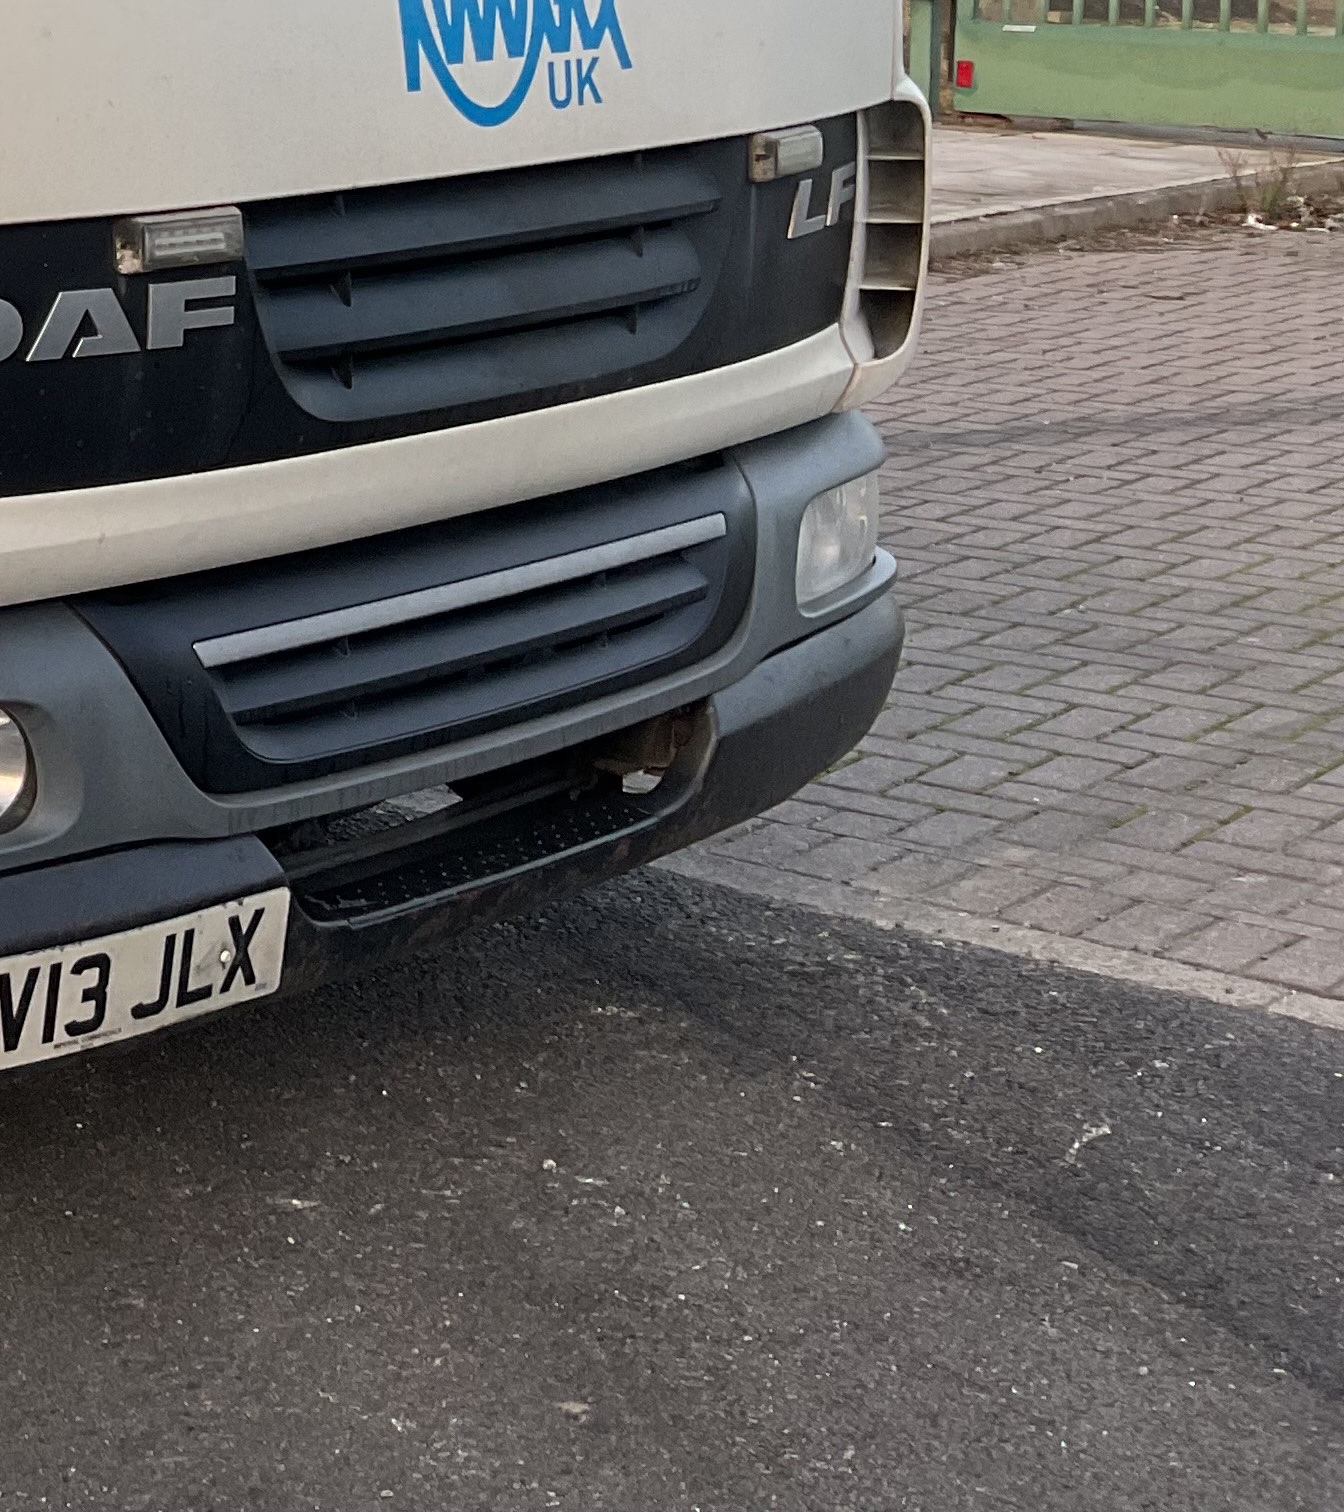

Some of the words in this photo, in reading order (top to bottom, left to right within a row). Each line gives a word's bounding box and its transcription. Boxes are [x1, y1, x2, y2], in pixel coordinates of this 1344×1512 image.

[548, 56, 603, 110] UK
[787, 161, 857, 240] LF
[131, 908, 265, 1021] JLX
